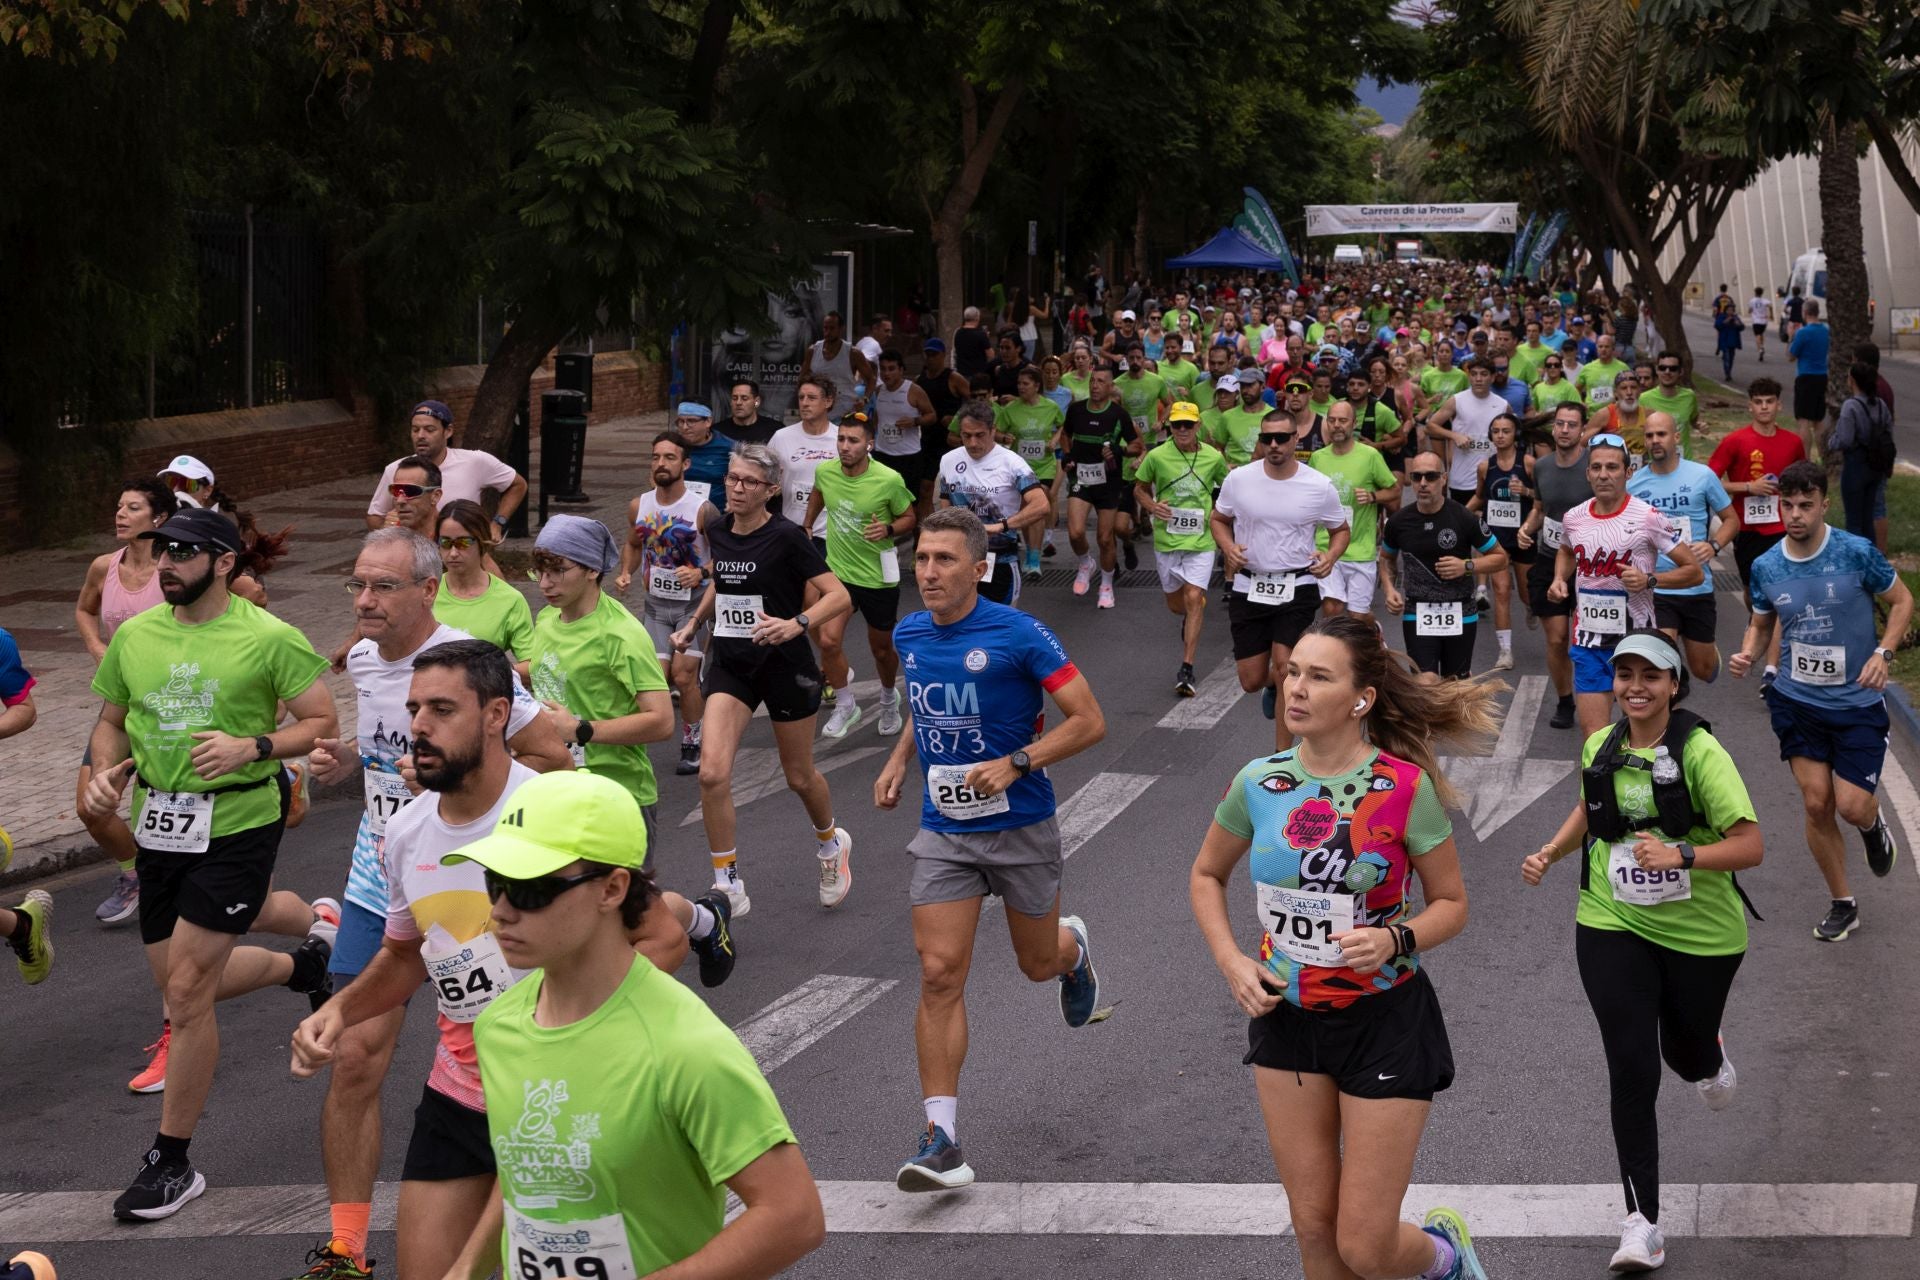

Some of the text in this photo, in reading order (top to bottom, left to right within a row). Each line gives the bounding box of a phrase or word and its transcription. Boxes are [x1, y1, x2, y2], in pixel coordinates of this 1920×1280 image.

[1361, 207, 1399, 215] Carrera
[1430, 206, 1465, 214] Prensa
[796, 273, 833, 291] ASE
[726, 363, 801, 373] CABLO GLO
[1021, 446, 1041, 454] 700
[796, 491, 812, 501] 67
[1645, 493, 1690, 510] erja
[1490, 509, 1517, 518] 1090
[1749, 505, 1772, 515] 361
[1172, 517, 1198, 527] 788
[716, 561, 756, 572] OYSHO
[654, 577, 683, 591] 969
[1256, 582, 1286, 596] 837
[722, 609, 755, 625] 108
[1423, 614, 1455, 626] 318
[1583, 607, 1619, 620] 1049
[1798, 656, 1836, 674] 678
[909, 681, 980, 716] RCM
[918, 728, 986, 754] 1873
[373, 794, 415, 816] 17
[145, 809, 196, 834] 557
[1295, 810, 1335, 825] Chupa
[1288, 823, 1329, 839] Chups
[1616, 866, 1680, 885] 1696
[1282, 893, 1321, 909] Carrera
[1270, 910, 1333, 945] 701
[496, 1136, 570, 1166] Carrera
[512, 1164, 585, 1187] Prensa
[518, 1246, 609, 1280] 619
